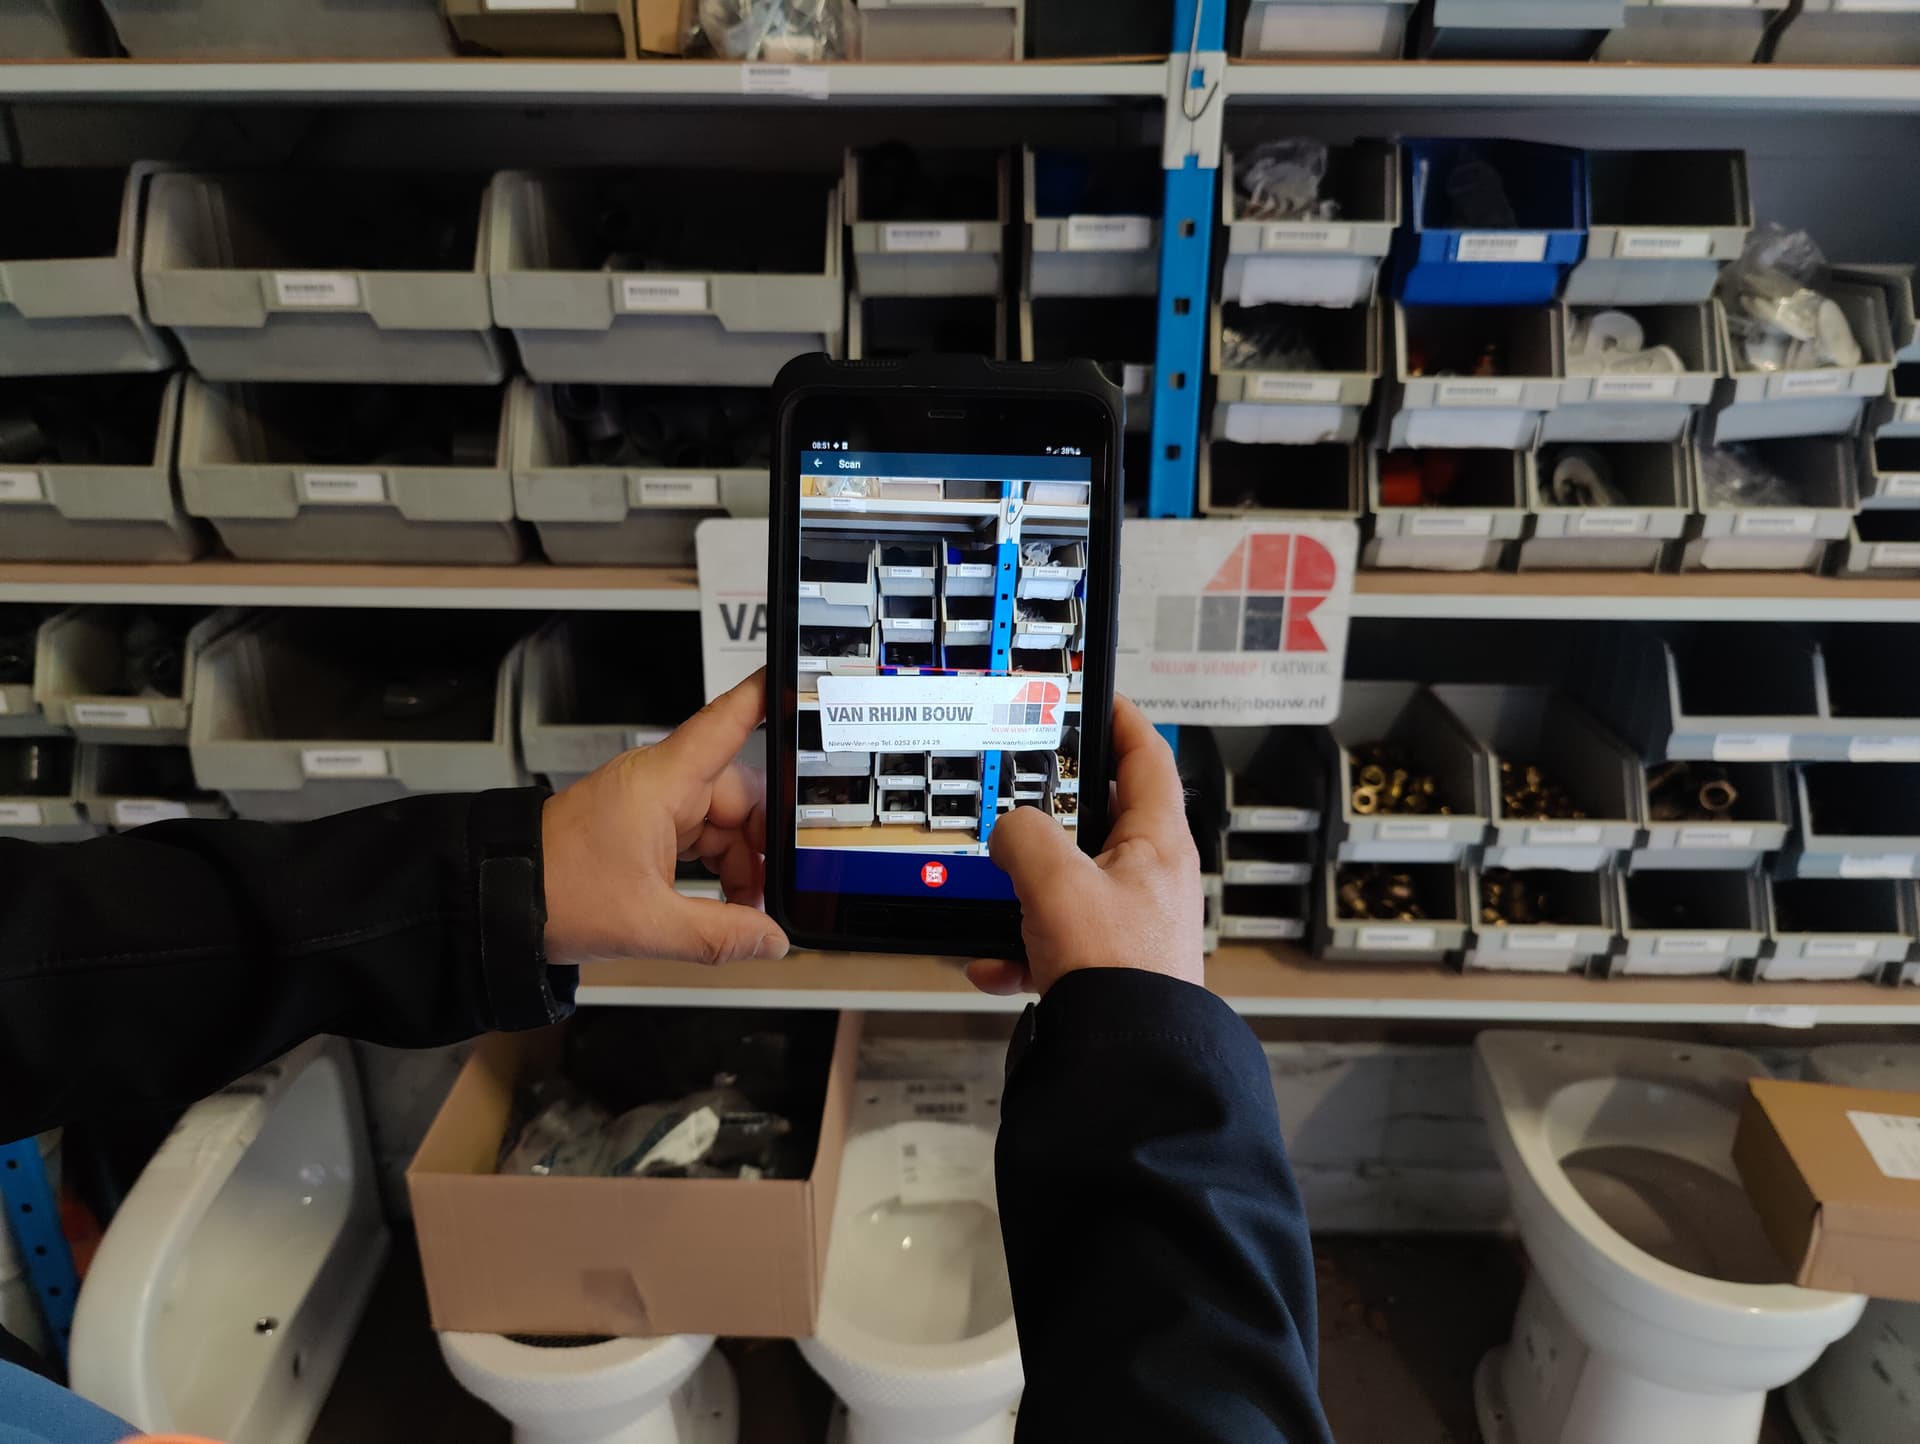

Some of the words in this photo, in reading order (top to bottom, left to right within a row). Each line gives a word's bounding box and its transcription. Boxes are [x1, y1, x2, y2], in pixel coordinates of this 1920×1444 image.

[812, 442, 830, 450] 08:51
[838, 459, 861, 469] Scan
[826, 706, 863, 722] VAN
[869, 706, 917, 722] RHIJN
[922, 706, 974, 722] BOUW
